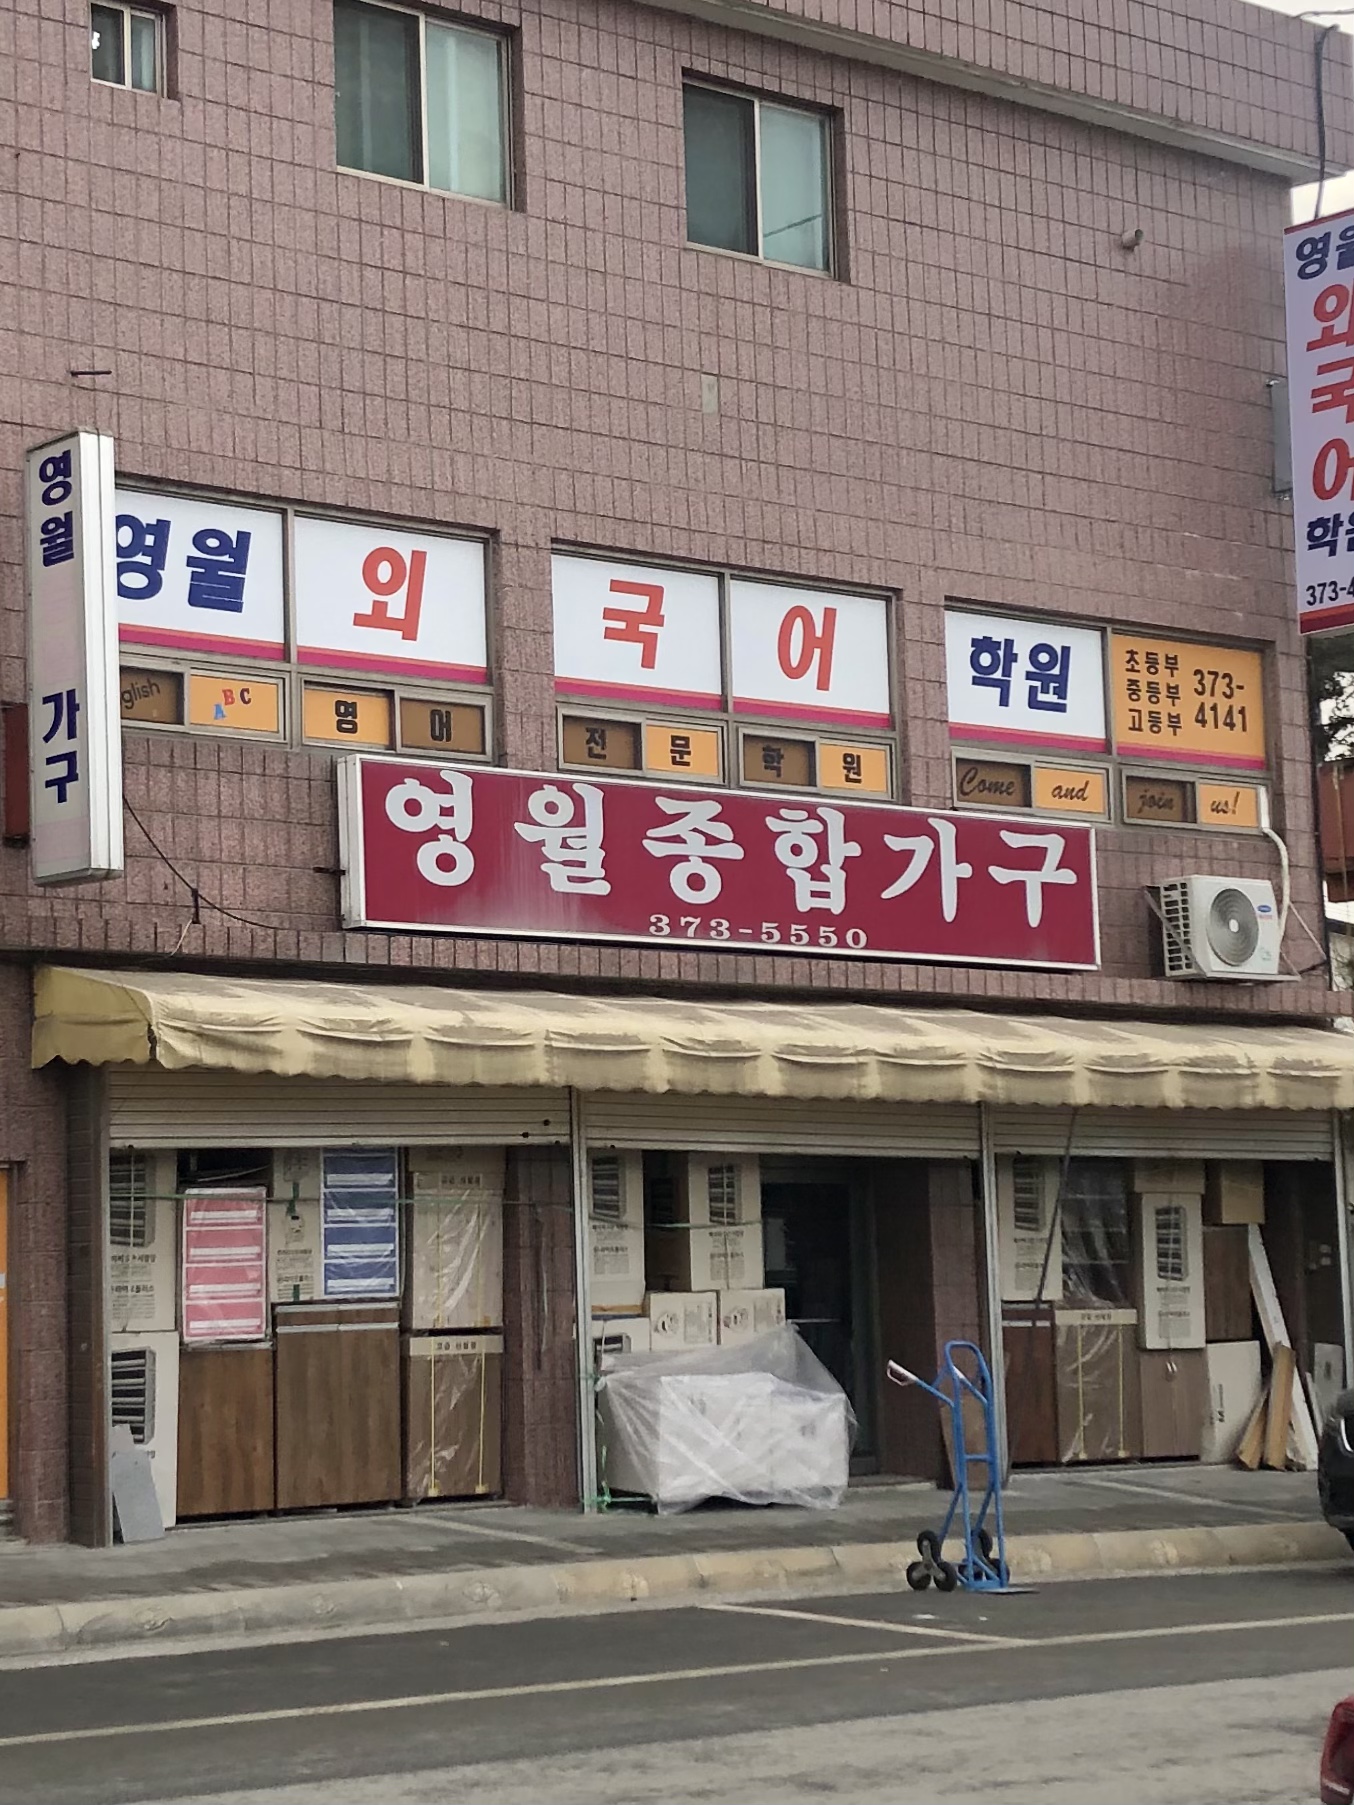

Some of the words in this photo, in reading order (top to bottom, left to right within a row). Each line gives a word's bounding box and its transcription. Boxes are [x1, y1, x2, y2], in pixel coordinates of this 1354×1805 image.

[39, 449, 75, 567] 영월
[1307, 512, 1354, 557] 학
[115, 514, 252, 613] 영월
[970, 636, 1071, 713] 학원
[1125, 648, 1180, 677] 초등부
[120, 678, 161, 709] glish
[1126, 678, 1182, 706] 중등부
[1193, 669, 1245, 699] 373-
[1128, 708, 1183, 736] 고등부
[1194, 702, 1248, 732] 4141
[42, 688, 80, 804] 가구
[960, 766, 1015, 797] Come
[1051, 780, 1090, 802] and
[1138, 790, 1176, 814] join
[1210, 791, 1241, 815] us!
[649, 913, 869, 949] 373-5550
